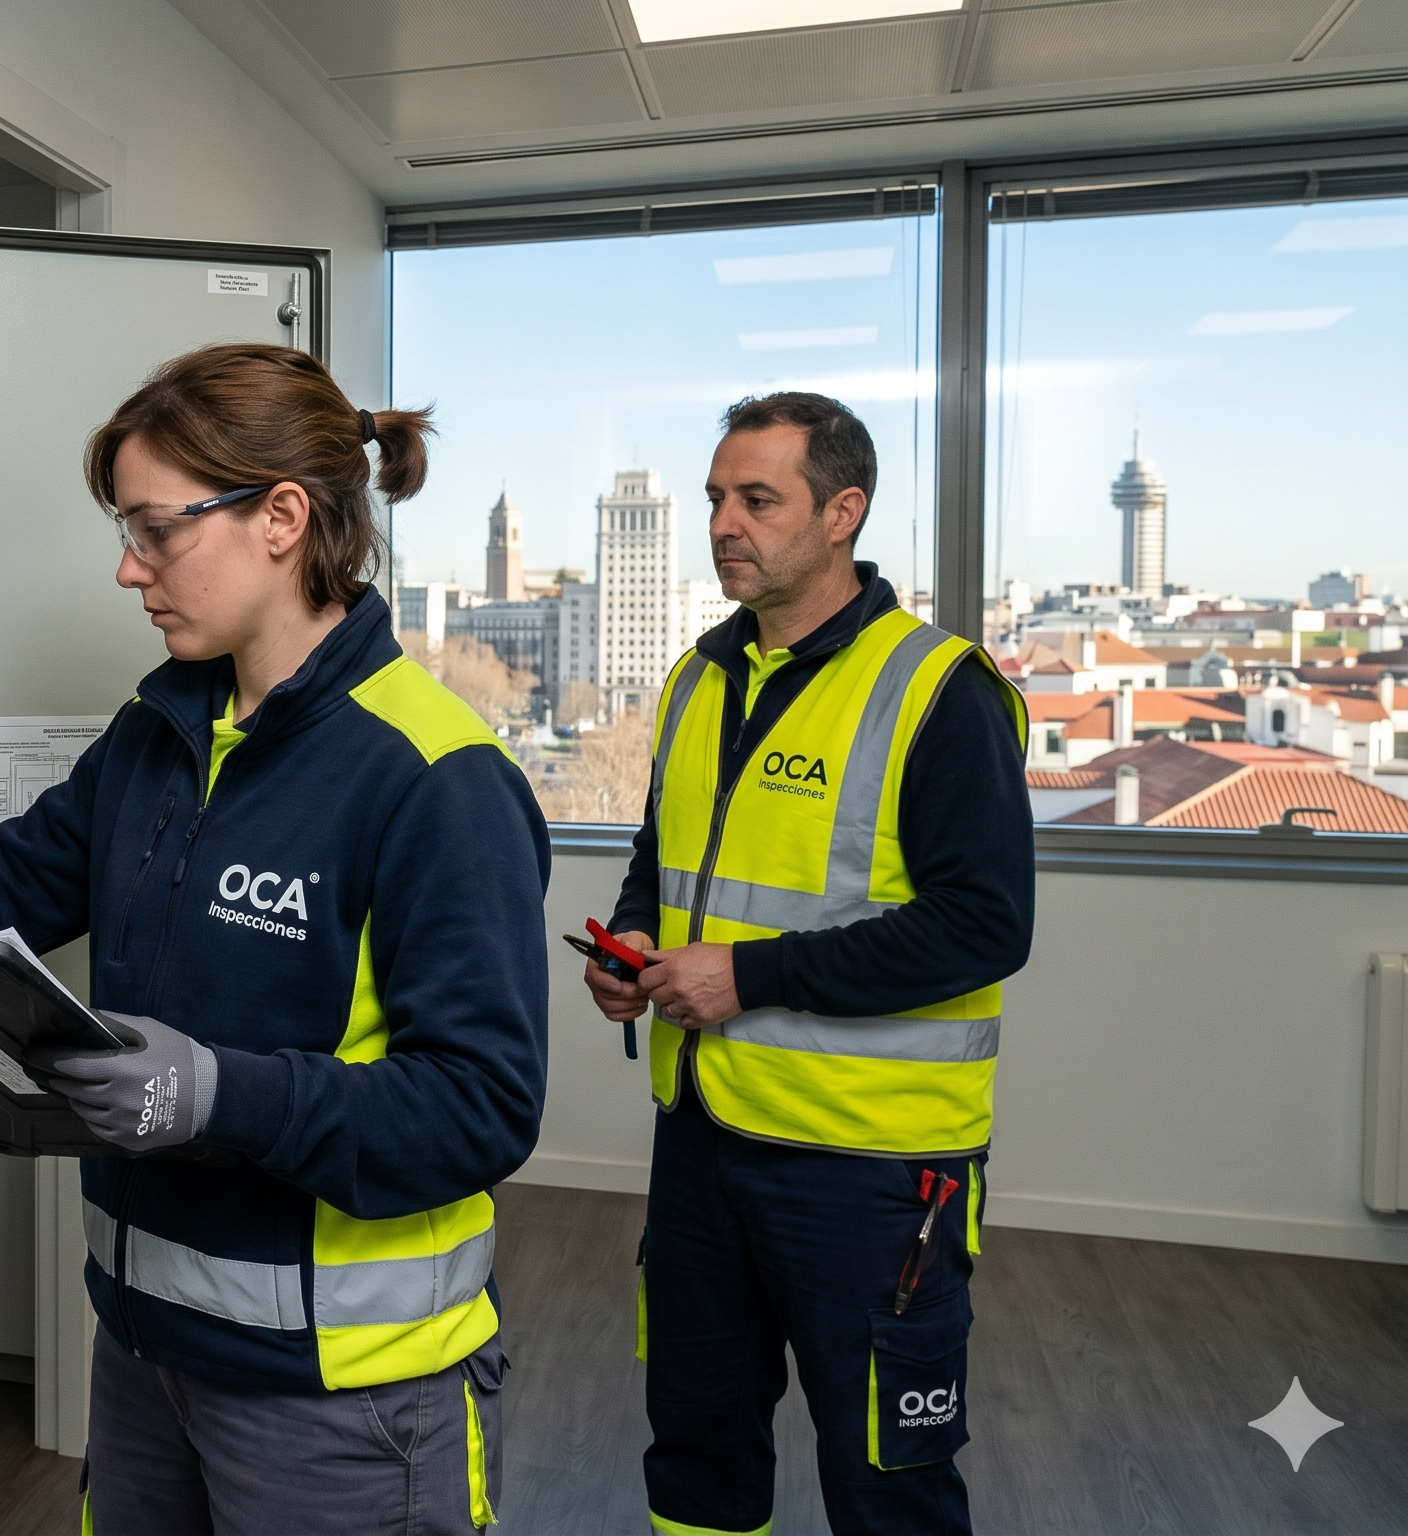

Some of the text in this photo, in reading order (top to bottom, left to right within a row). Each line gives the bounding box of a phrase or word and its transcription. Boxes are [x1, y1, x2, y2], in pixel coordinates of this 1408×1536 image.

[763, 751, 828, 787] OCA
[758, 778, 826, 800] Inspecciones
[208, 900, 307, 941] Inspecciones
[899, 1380, 958, 1416] OCA
